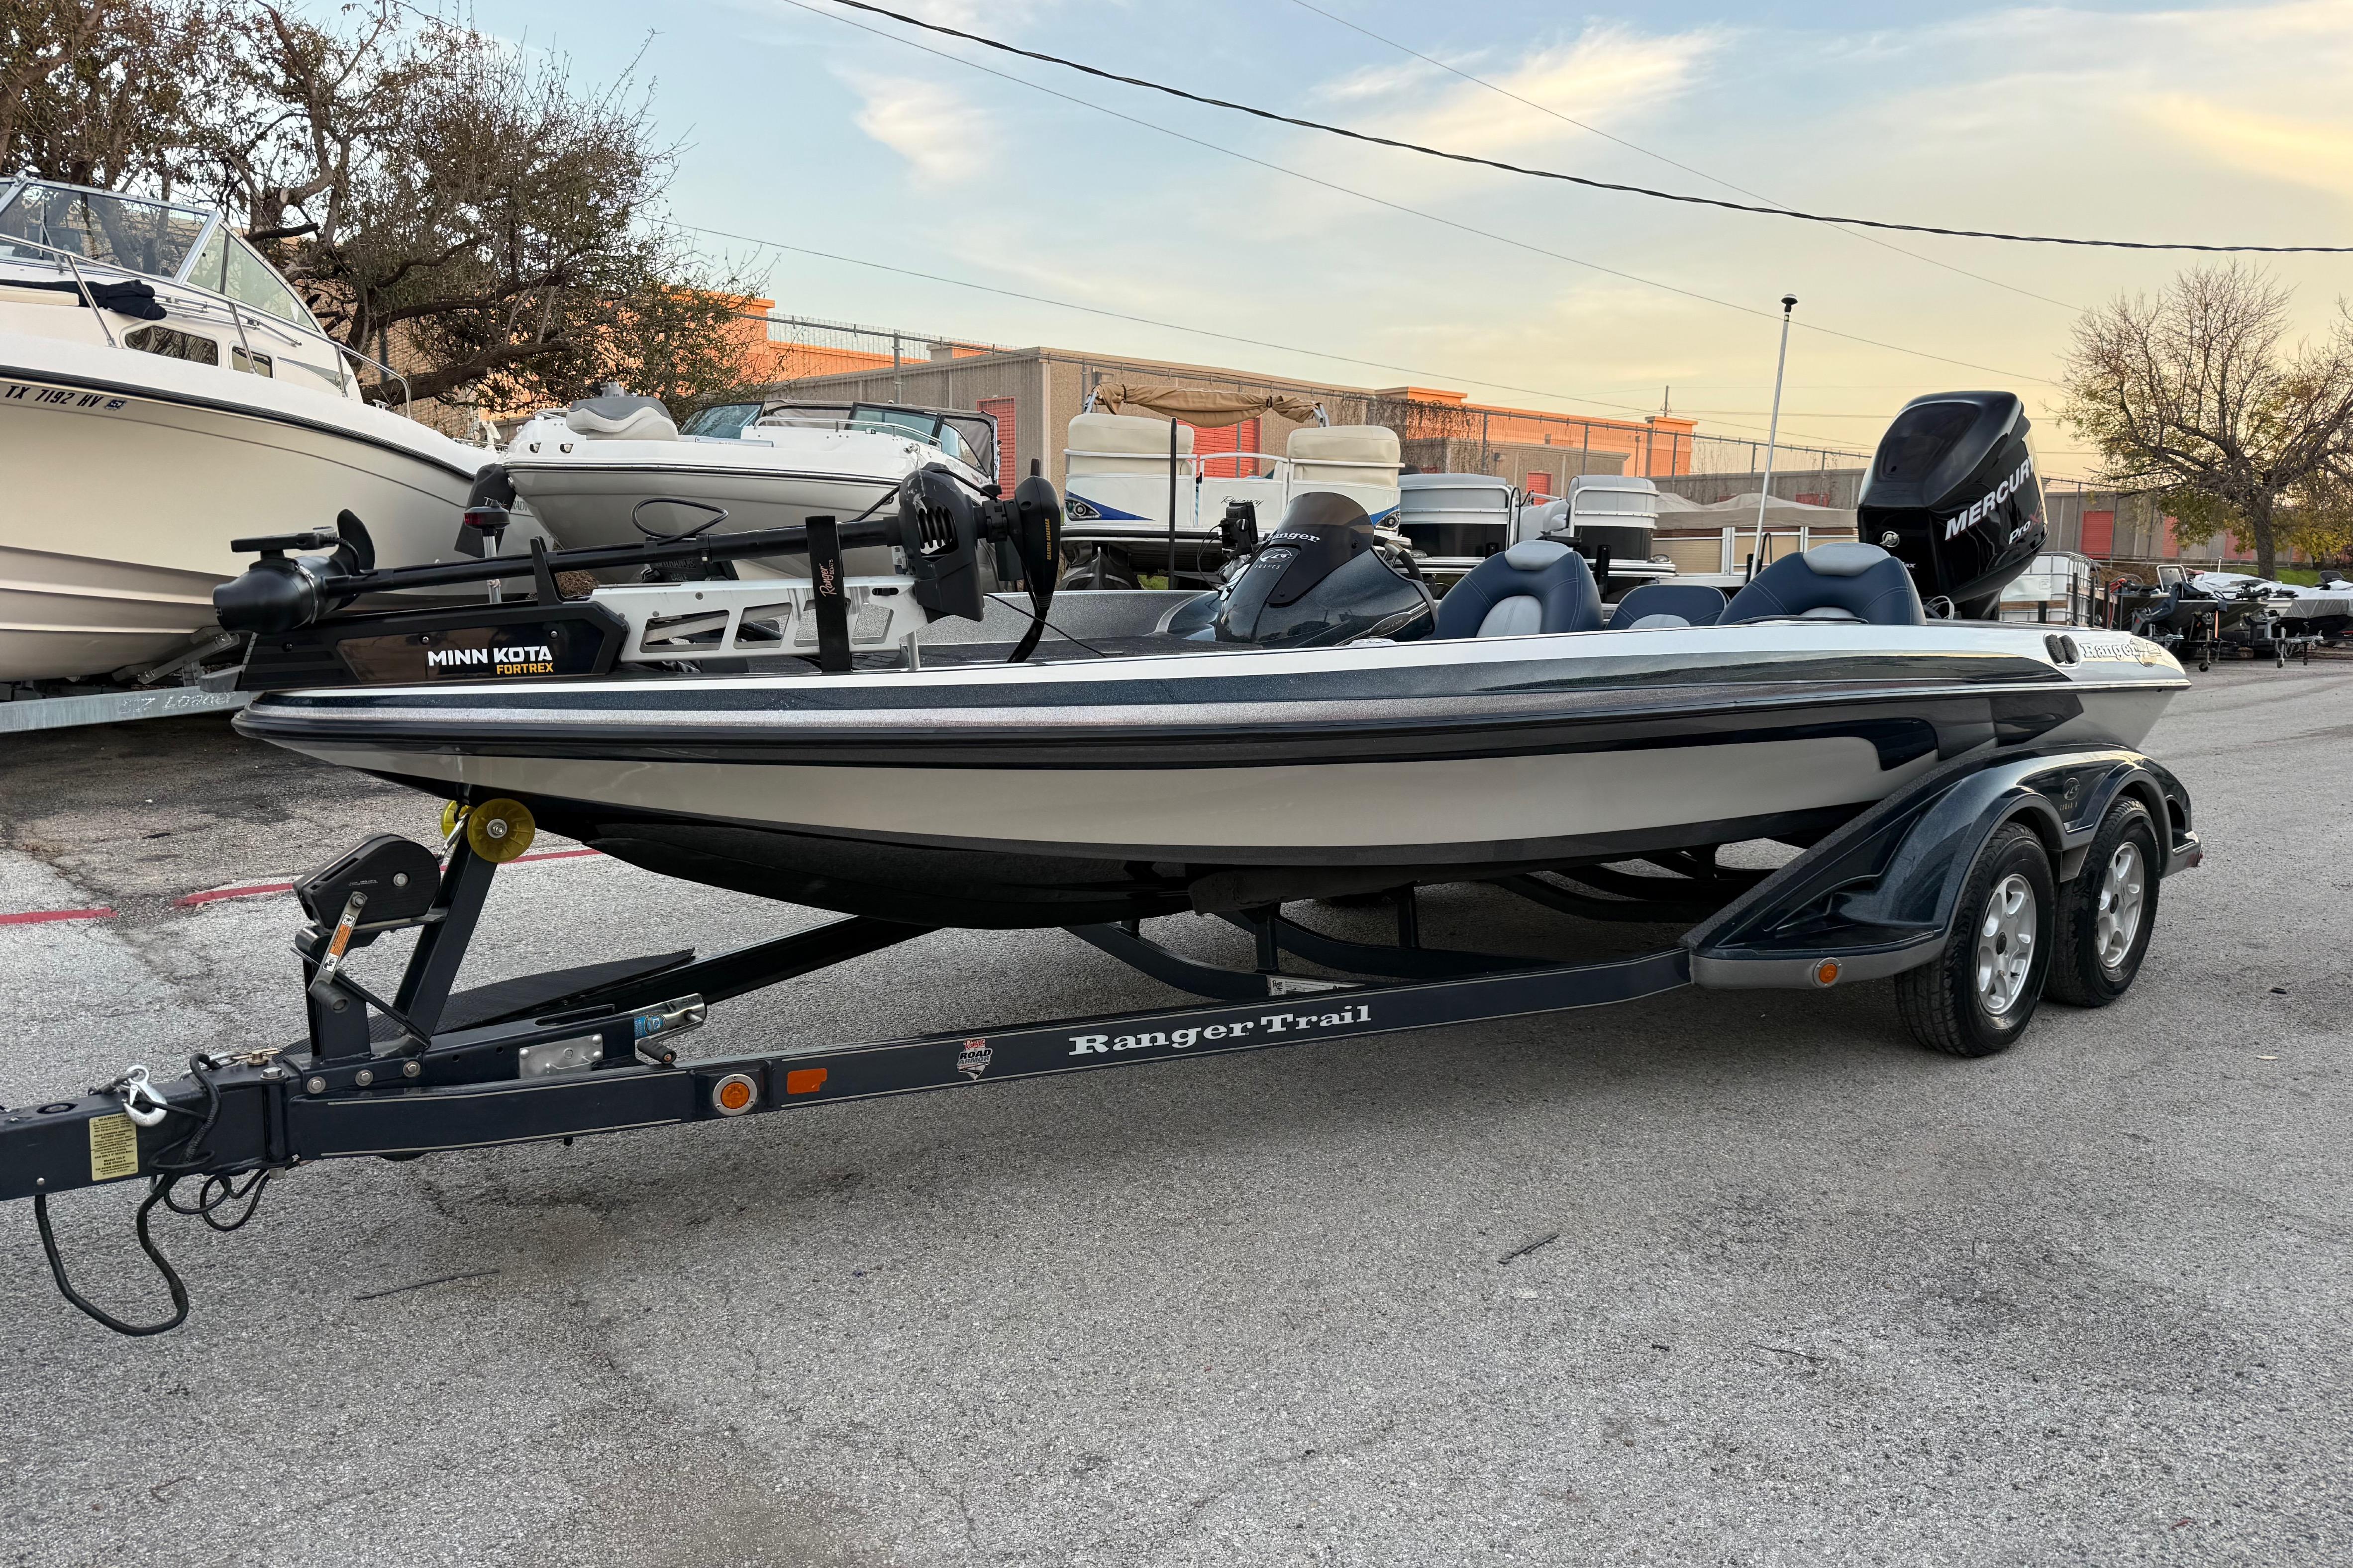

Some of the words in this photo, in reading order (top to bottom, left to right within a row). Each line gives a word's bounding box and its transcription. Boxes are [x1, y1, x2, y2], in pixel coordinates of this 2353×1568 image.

[5, 386, 31, 399] TX
[35, 389, 76, 404] 7192
[76, 394, 103, 407] HV
[819, 565, 837, 597] Ranger
[427, 648, 489, 666] MINN
[493, 646, 553, 663] KOTA
[2079, 643, 2140, 661] Ranger
[496, 662, 554, 675] FORTREX
[1068, 1020, 1254, 1056] Ranger
[1260, 1005, 1371, 1034] Trail
[964, 1039, 986, 1051] Ranger
[958, 1056, 990, 1065] ARMOR
[959, 1049, 992, 1060] ROAD
